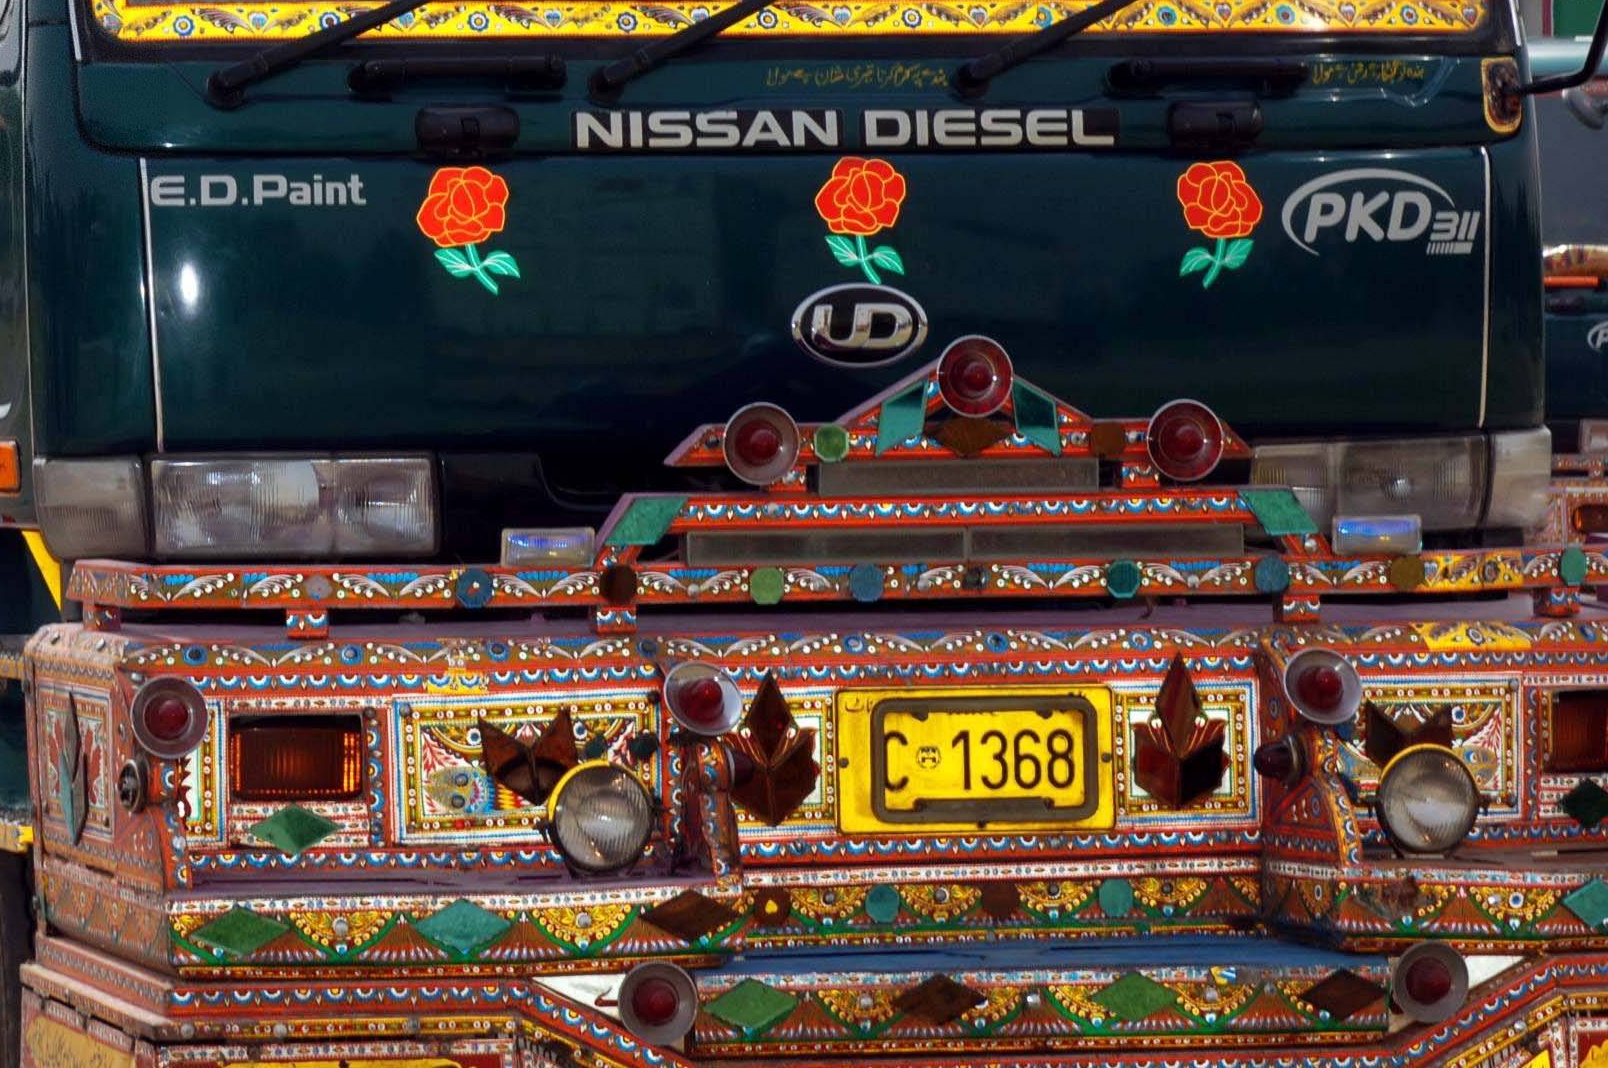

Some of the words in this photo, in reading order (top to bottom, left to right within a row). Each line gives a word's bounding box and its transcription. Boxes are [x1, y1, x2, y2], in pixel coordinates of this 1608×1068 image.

[576, 111, 838, 148] NISSAN
[864, 109, 1115, 146] DIESEL
[151, 174, 367, 206] E.D.Paint
[1304, 190, 1432, 243] PKD
[812, 303, 913, 350] UD
[952, 729, 1076, 790] 1368
